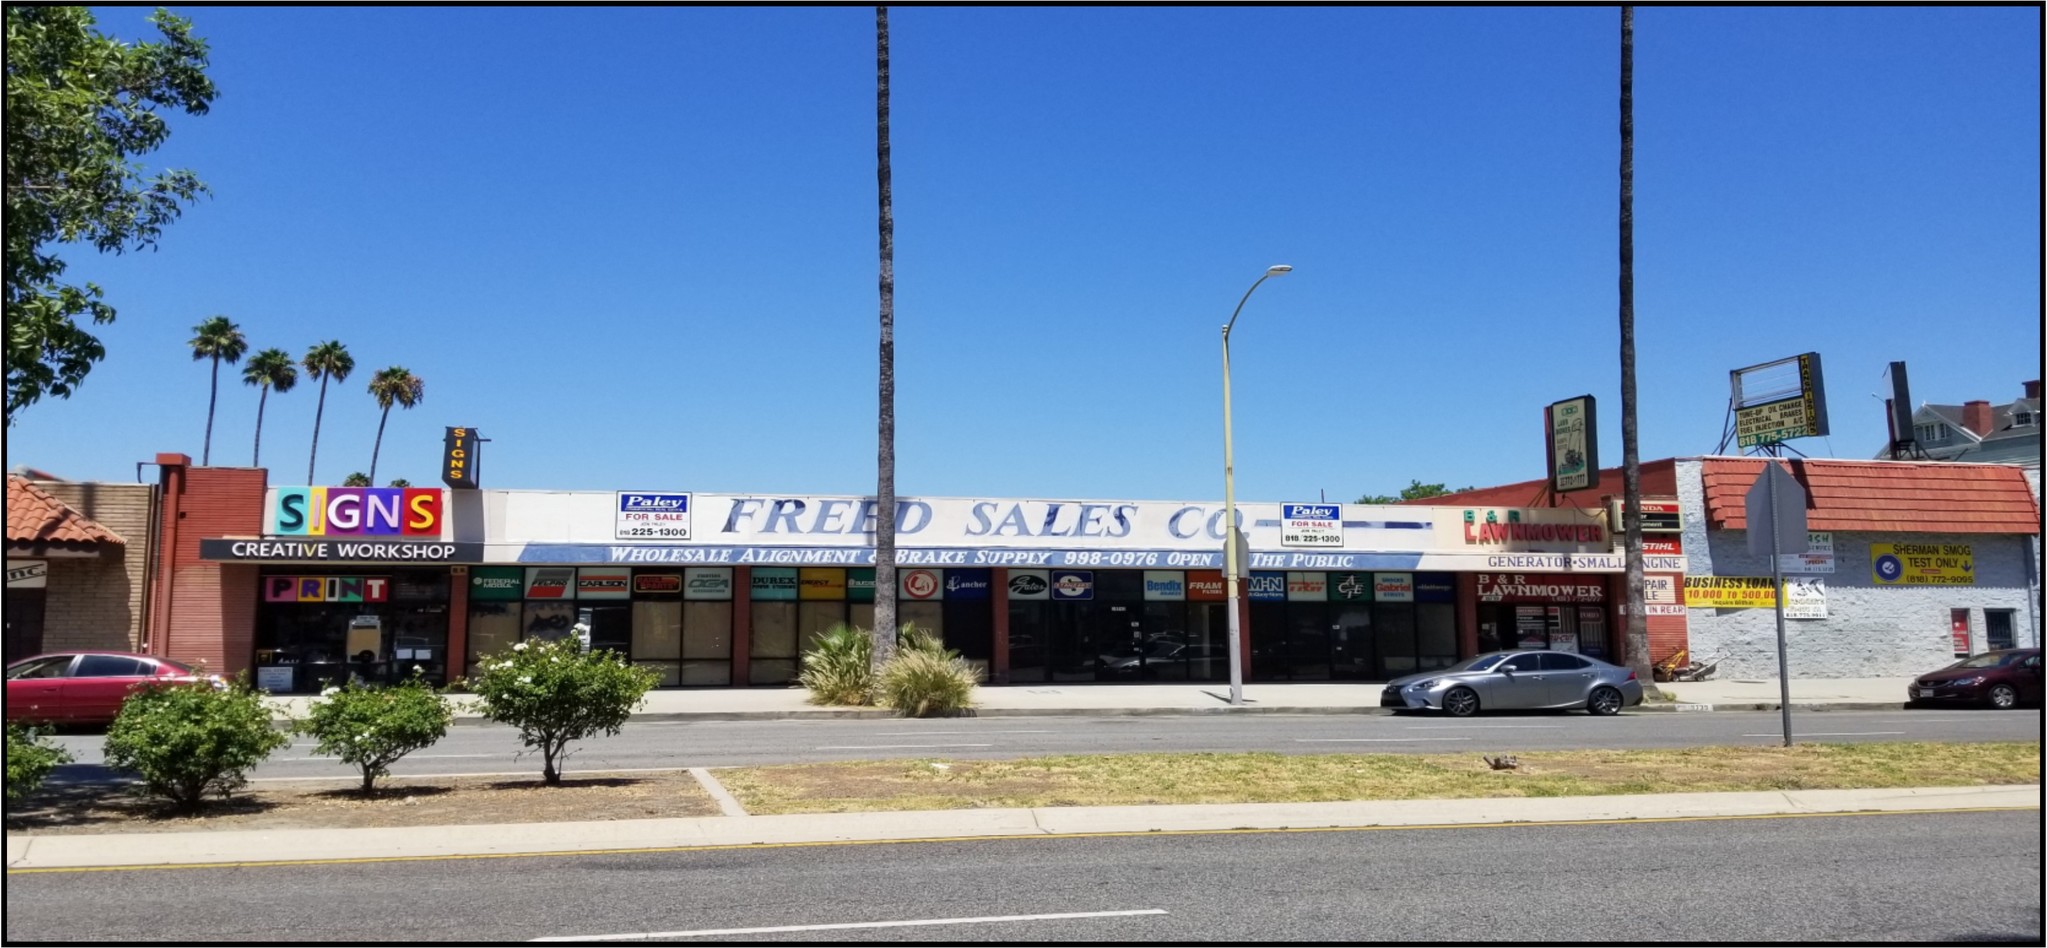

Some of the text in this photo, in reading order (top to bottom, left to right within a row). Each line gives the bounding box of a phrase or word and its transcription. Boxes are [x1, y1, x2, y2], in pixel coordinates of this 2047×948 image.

[1801, 357, 1816, 434] TRANSMISSIONS
[1739, 400, 1802, 420] TUNE-UP OIL CHANGE
[1739, 409, 1803, 427] ELECTRICAL BRAKES
[1740, 416, 1804, 434] FUEL INJECTION A/C
[1739, 426, 1808, 446] 818 775-5722
[452, 427, 465, 479] SIGNS
[627, 496, 683, 508] Paley
[280, 493, 434, 530] SIGNS
[721, 498, 931, 535] FREED
[1291, 506, 1333, 516] Paley
[1463, 510, 1520, 521] B & R
[964, 502, 1139, 538] SALES
[1168, 506, 1249, 541] CO.
[631, 528, 687, 537] 225-1300
[1464, 524, 1604, 543] LAWNMOWER
[1808, 534, 1829, 542] ASH
[231, 542, 456, 559] CREATIVE WORKSHOP
[1642, 543, 1675, 551] STIHL
[1893, 544, 1971, 555] SHERMAN SMOG
[608, 546, 733, 563] WHOLESALE
[738, 547, 863, 563] ALIGNMENT
[896, 550, 967, 564] BRAKE
[975, 549, 1053, 566] SUPPLY
[1064, 551, 1158, 567] 998-0976
[1167, 552, 1213, 567] OPEN
[1250, 553, 1286, 567] THE
[1290, 554, 1354, 568] PUBLIC
[1488, 556, 1573, 568] GENERATOR
[1642, 558, 1681, 568] NGINE
[1908, 557, 1959, 569] TEST ONLY
[752, 577, 796, 585] DUREX
[1478, 574, 1526, 584] B & R
[1644, 580, 1667, 590] PAIR
[1685, 577, 1743, 588] BUSINESS
[1906, 576, 1973, 584] (818) 772-9095
[272, 579, 384, 598] PRINT
[1147, 580, 1182, 591] Bendix
[1376, 583, 1411, 592] Gabriel
[1477, 585, 1603, 597] LAWNMOWER
[1645, 591, 1659, 600] LE
[1727, 590, 1738, 599] TO
[1648, 606, 1658, 614] IN
